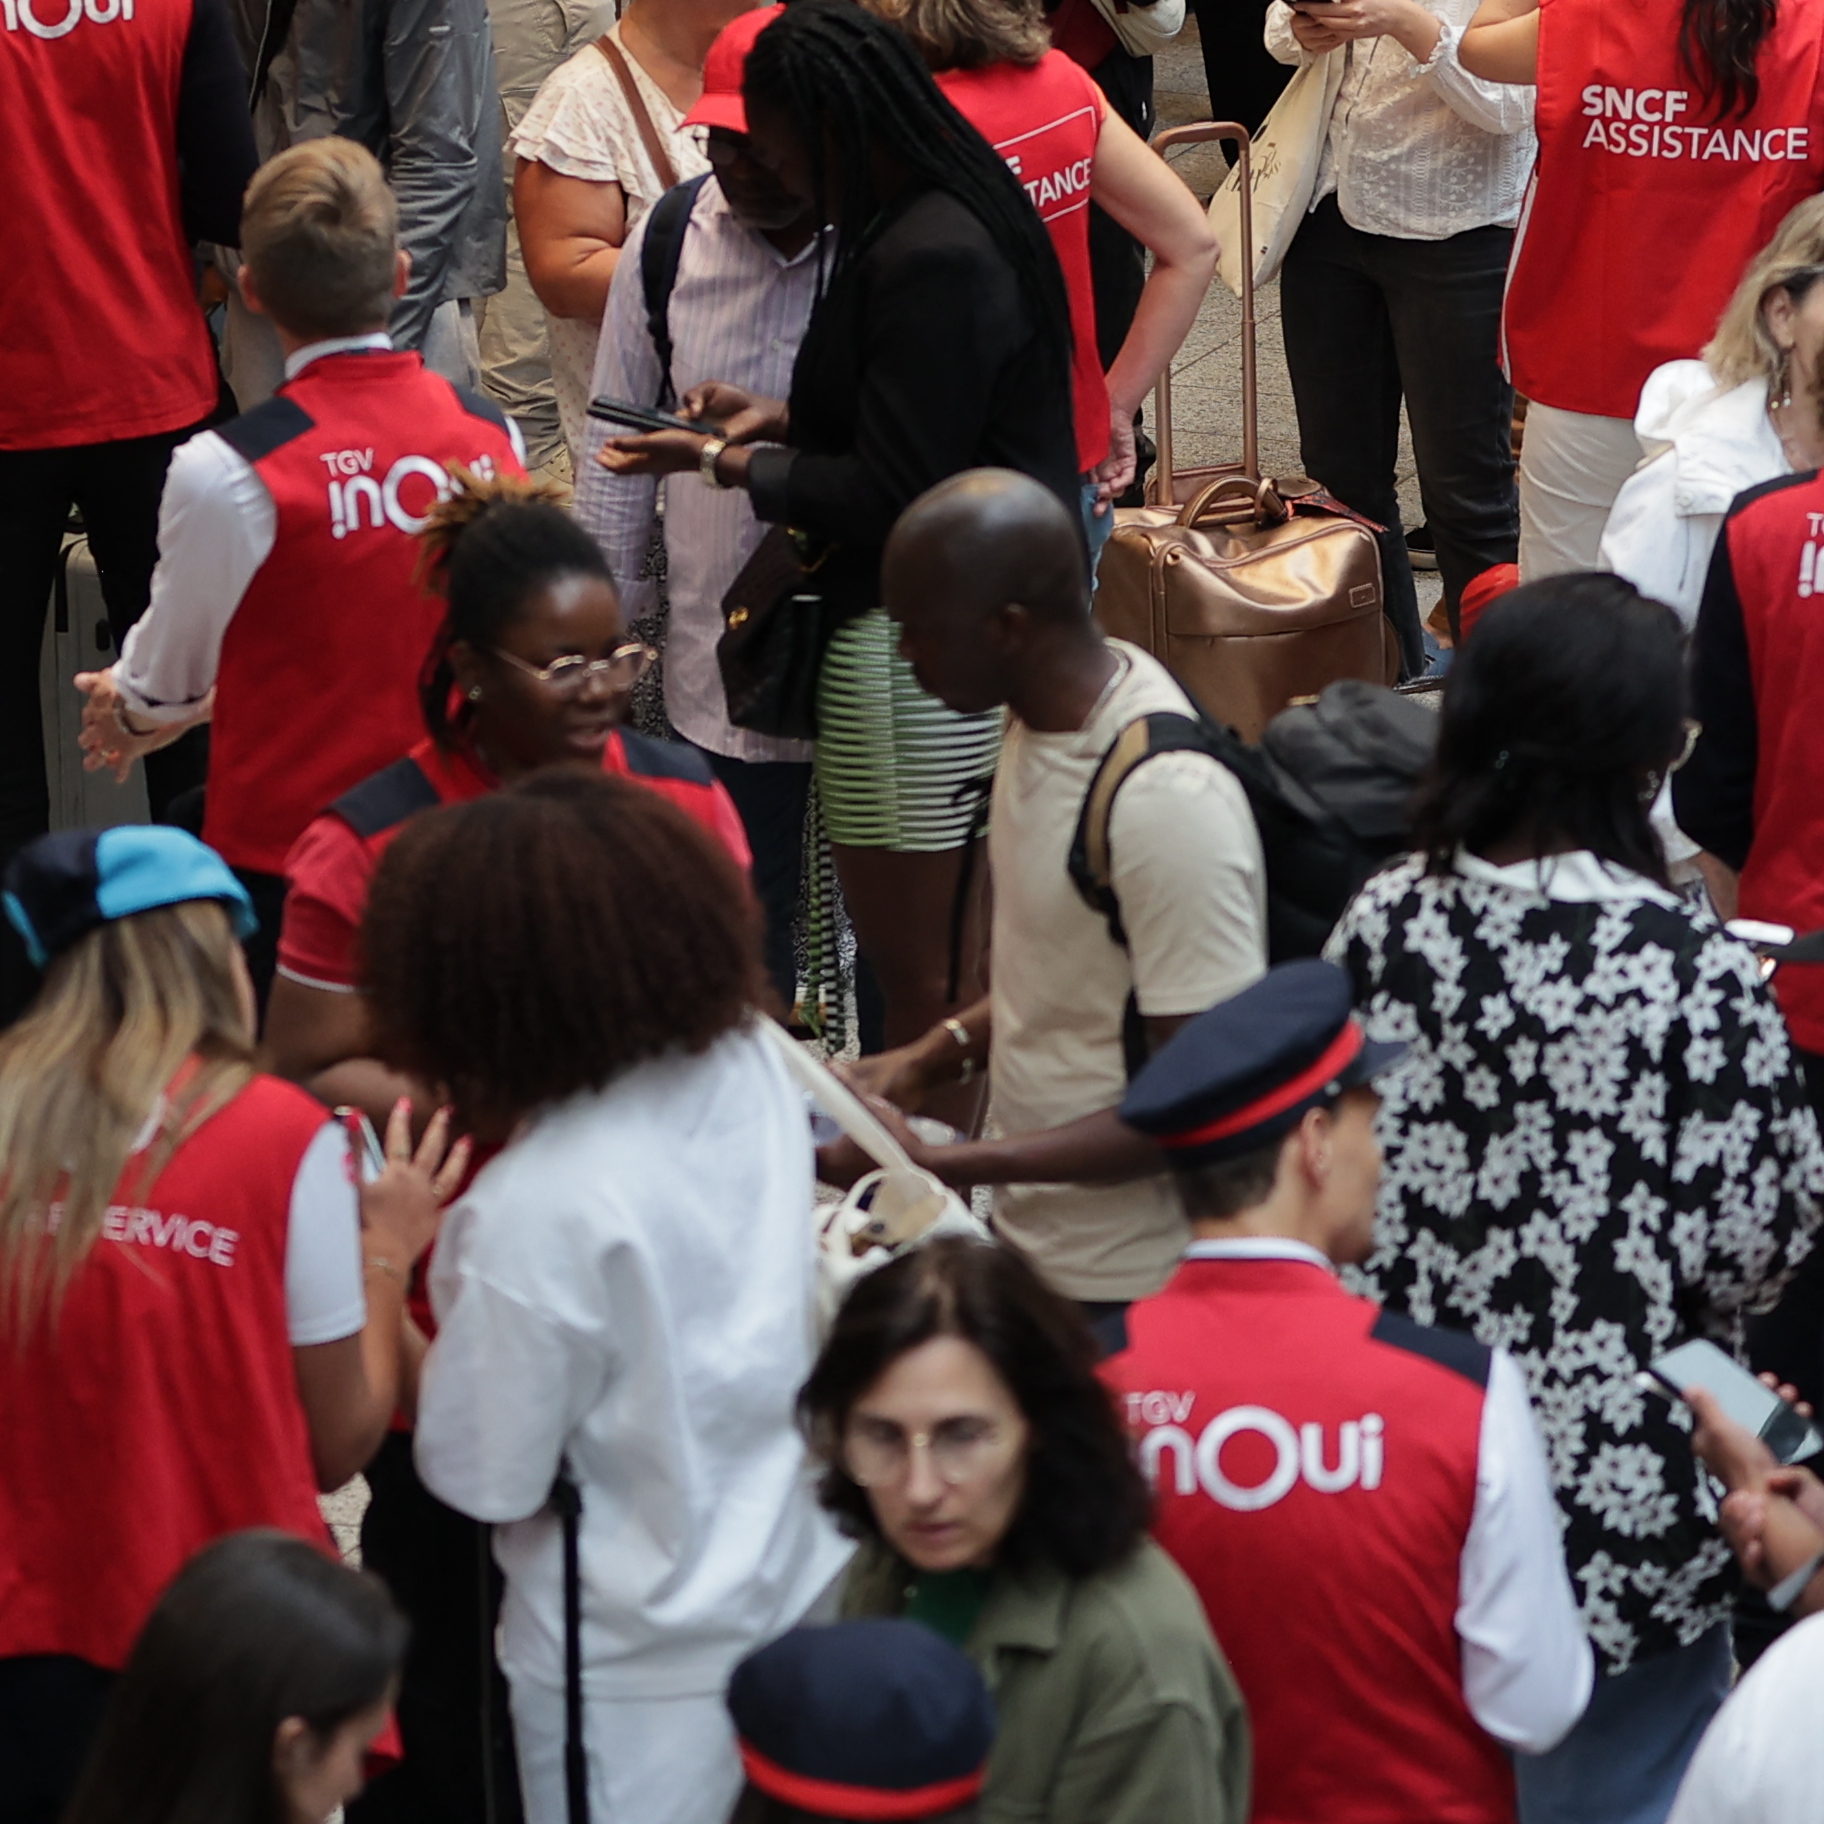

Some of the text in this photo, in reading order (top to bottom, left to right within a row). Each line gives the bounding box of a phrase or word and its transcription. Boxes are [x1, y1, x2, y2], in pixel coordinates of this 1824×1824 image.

[1581, 84, 1689, 123] SNCF
[1581, 119, 1810, 161] ASSISTANCE
[320, 447, 375, 478] TGV
